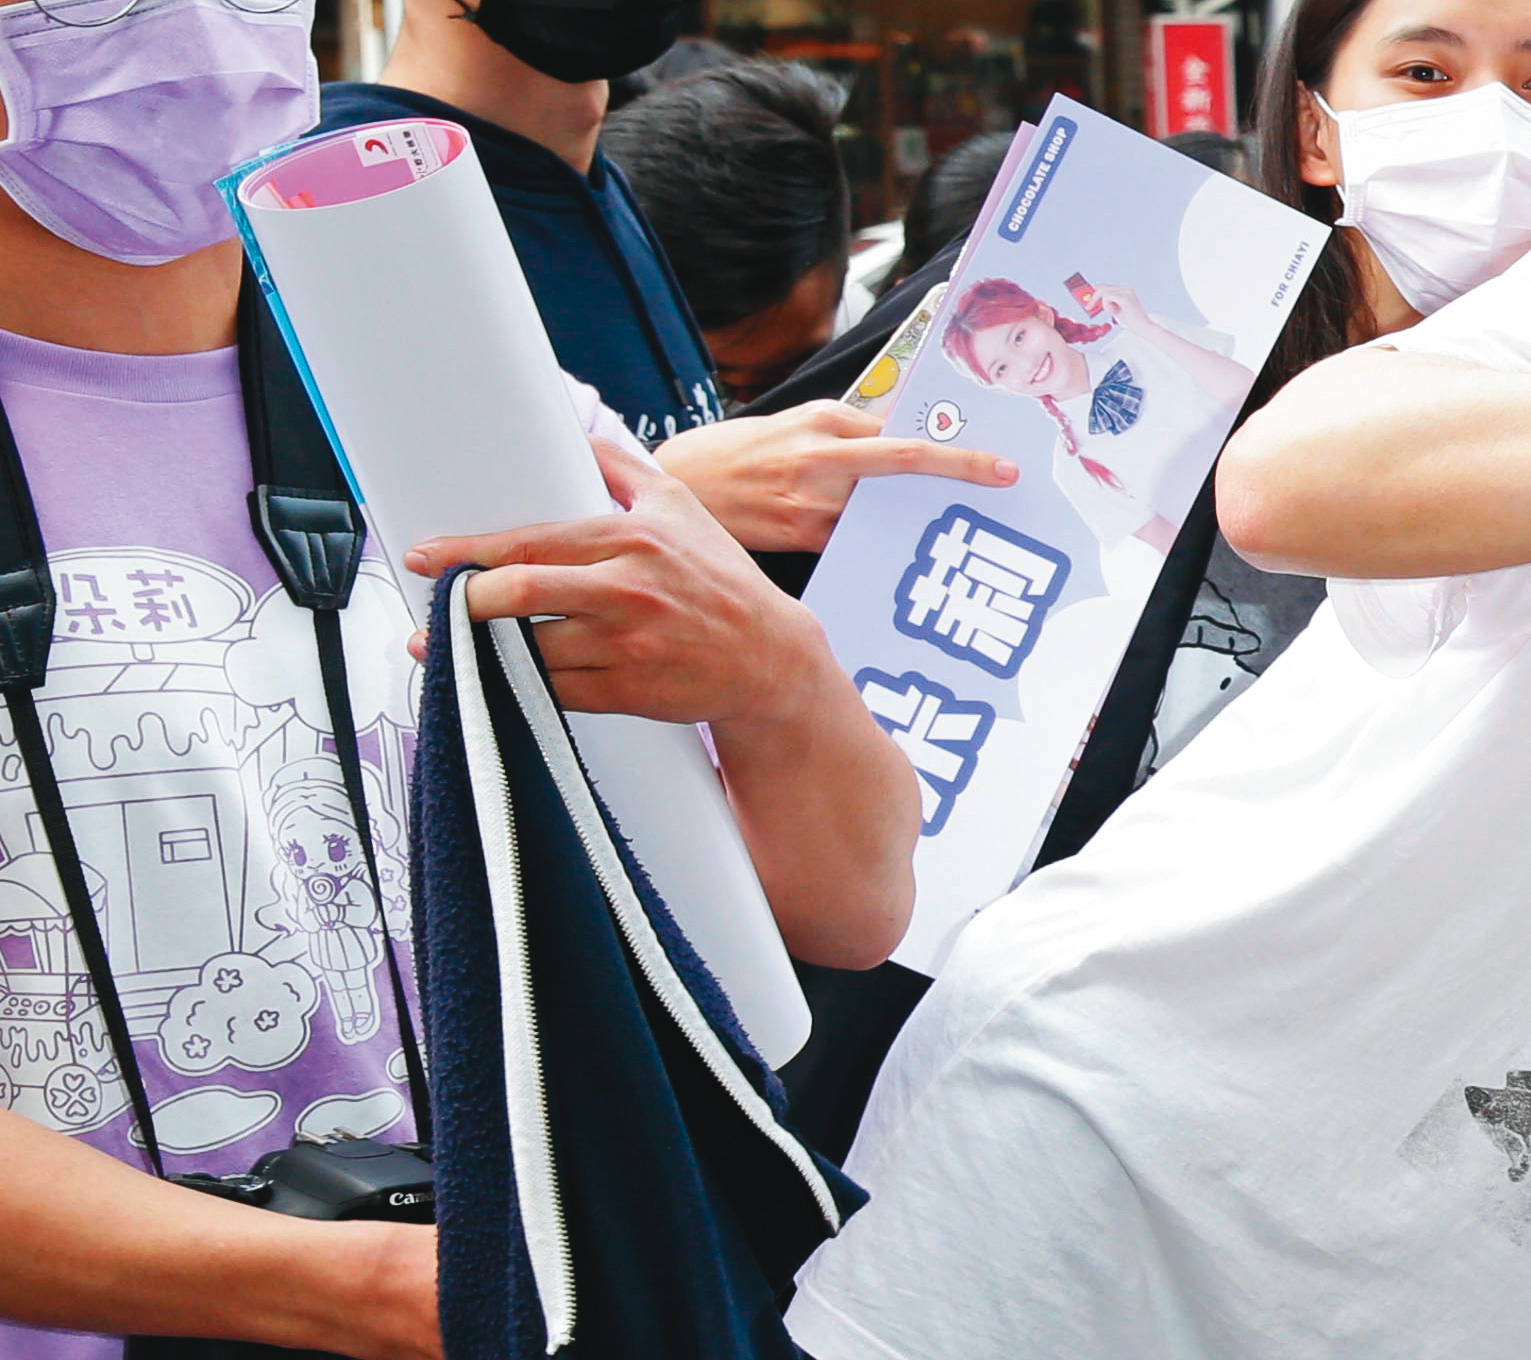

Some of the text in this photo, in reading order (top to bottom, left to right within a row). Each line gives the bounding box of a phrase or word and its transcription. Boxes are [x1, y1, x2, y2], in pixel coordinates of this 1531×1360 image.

[1008, 126, 1068, 233] CHOCOLATE SHOP
[1270, 240, 1312, 310] FOR CHIAYI
[60, 567, 200, 636] 朵莉
